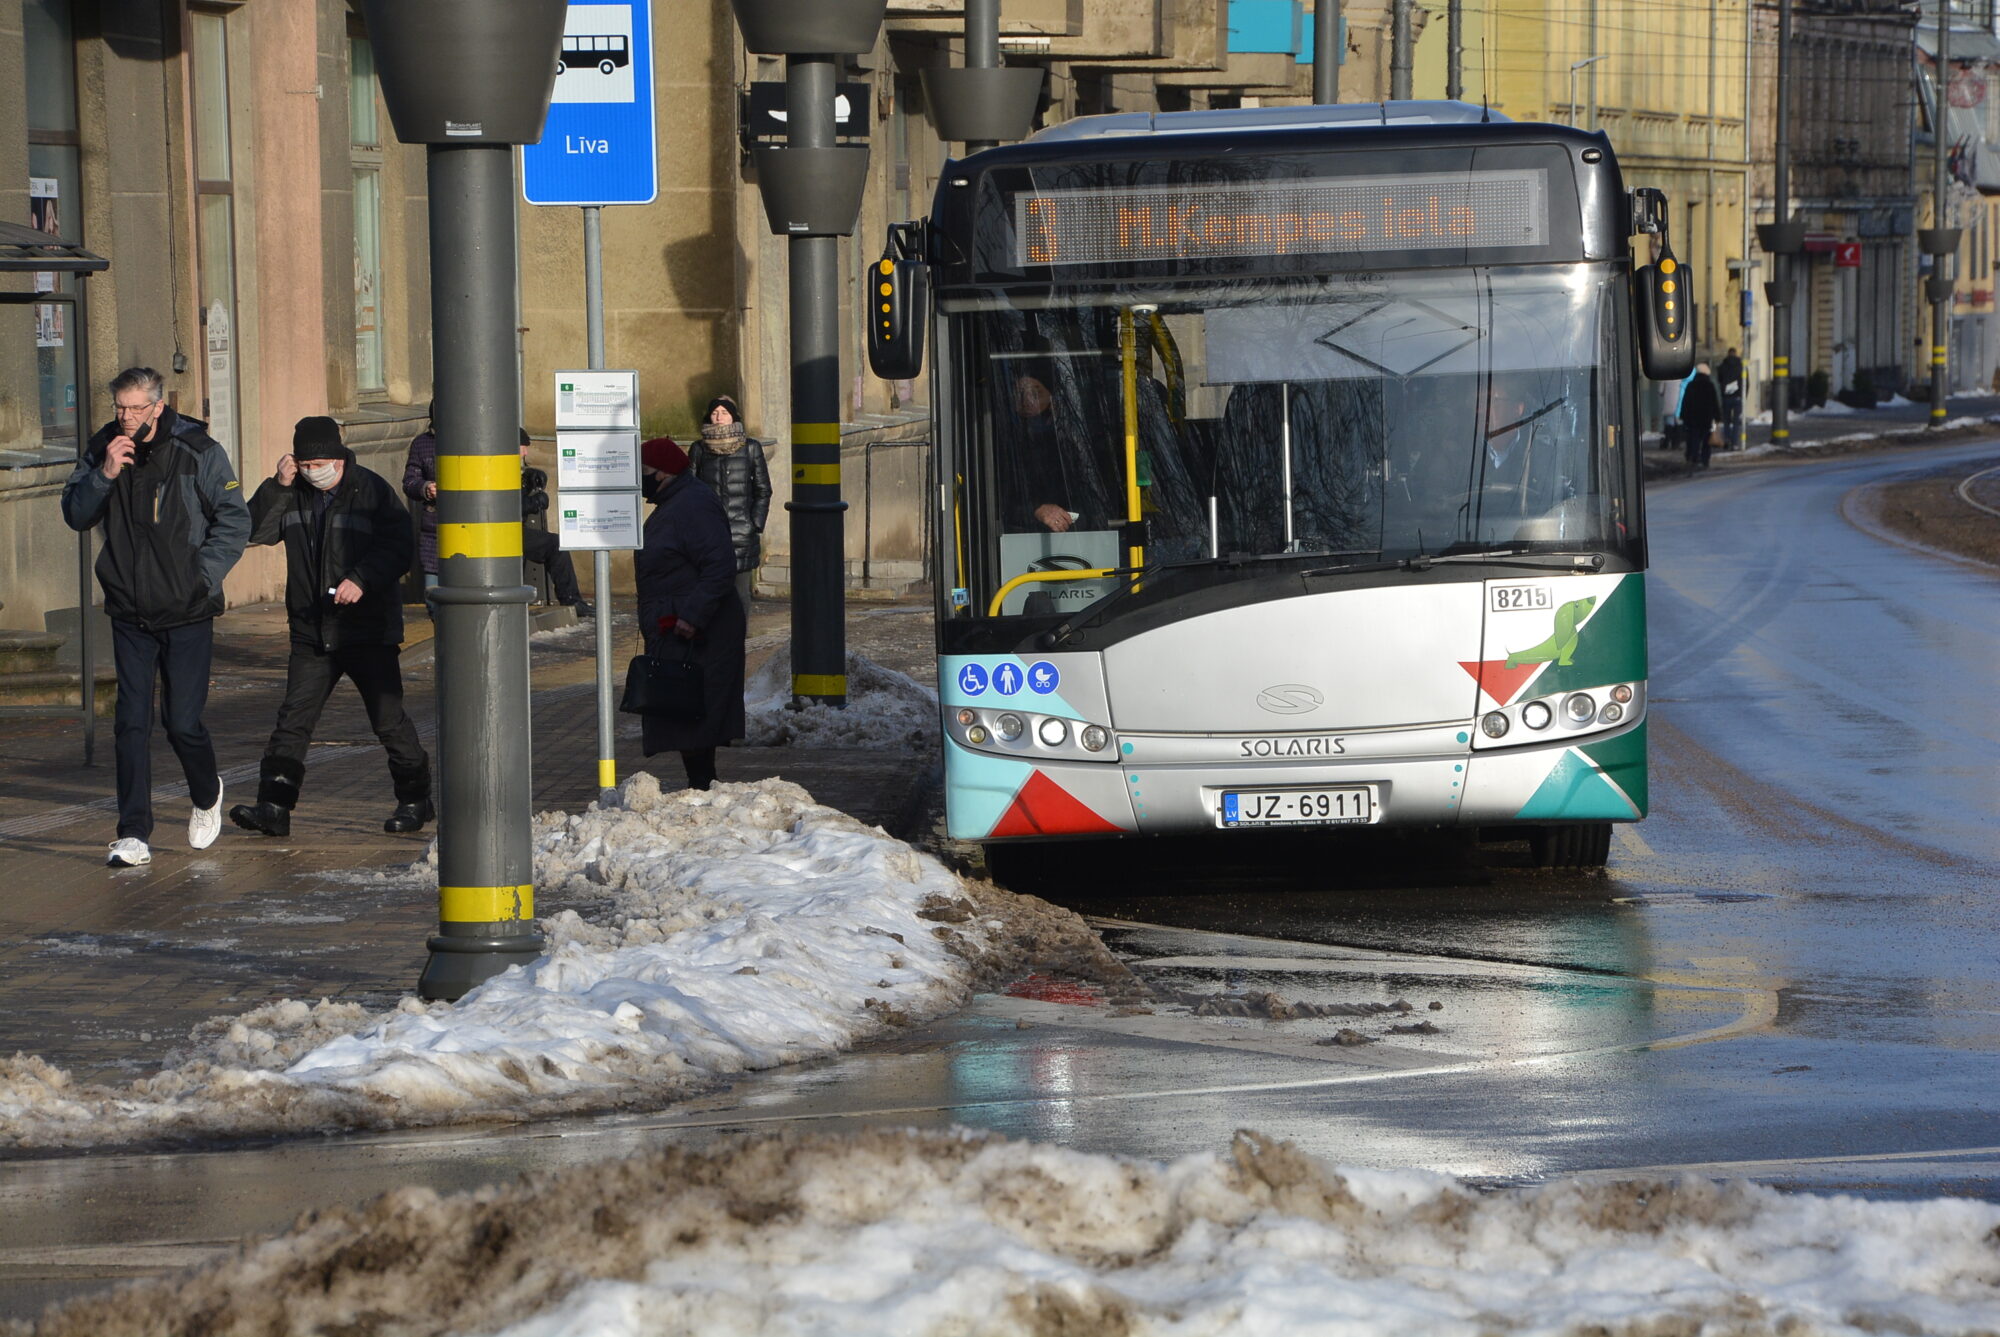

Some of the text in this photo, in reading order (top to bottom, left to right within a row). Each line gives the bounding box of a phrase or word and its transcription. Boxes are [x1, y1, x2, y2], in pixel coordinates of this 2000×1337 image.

[565, 134, 609, 154] Līva
[1027, 195, 1476, 263] 3 M.Kempes iela
[1497, 586, 1547, 609] 8215
[1240, 737, 1346, 757] SOLARIS
[1245, 793, 1361, 819] JZ-6911
